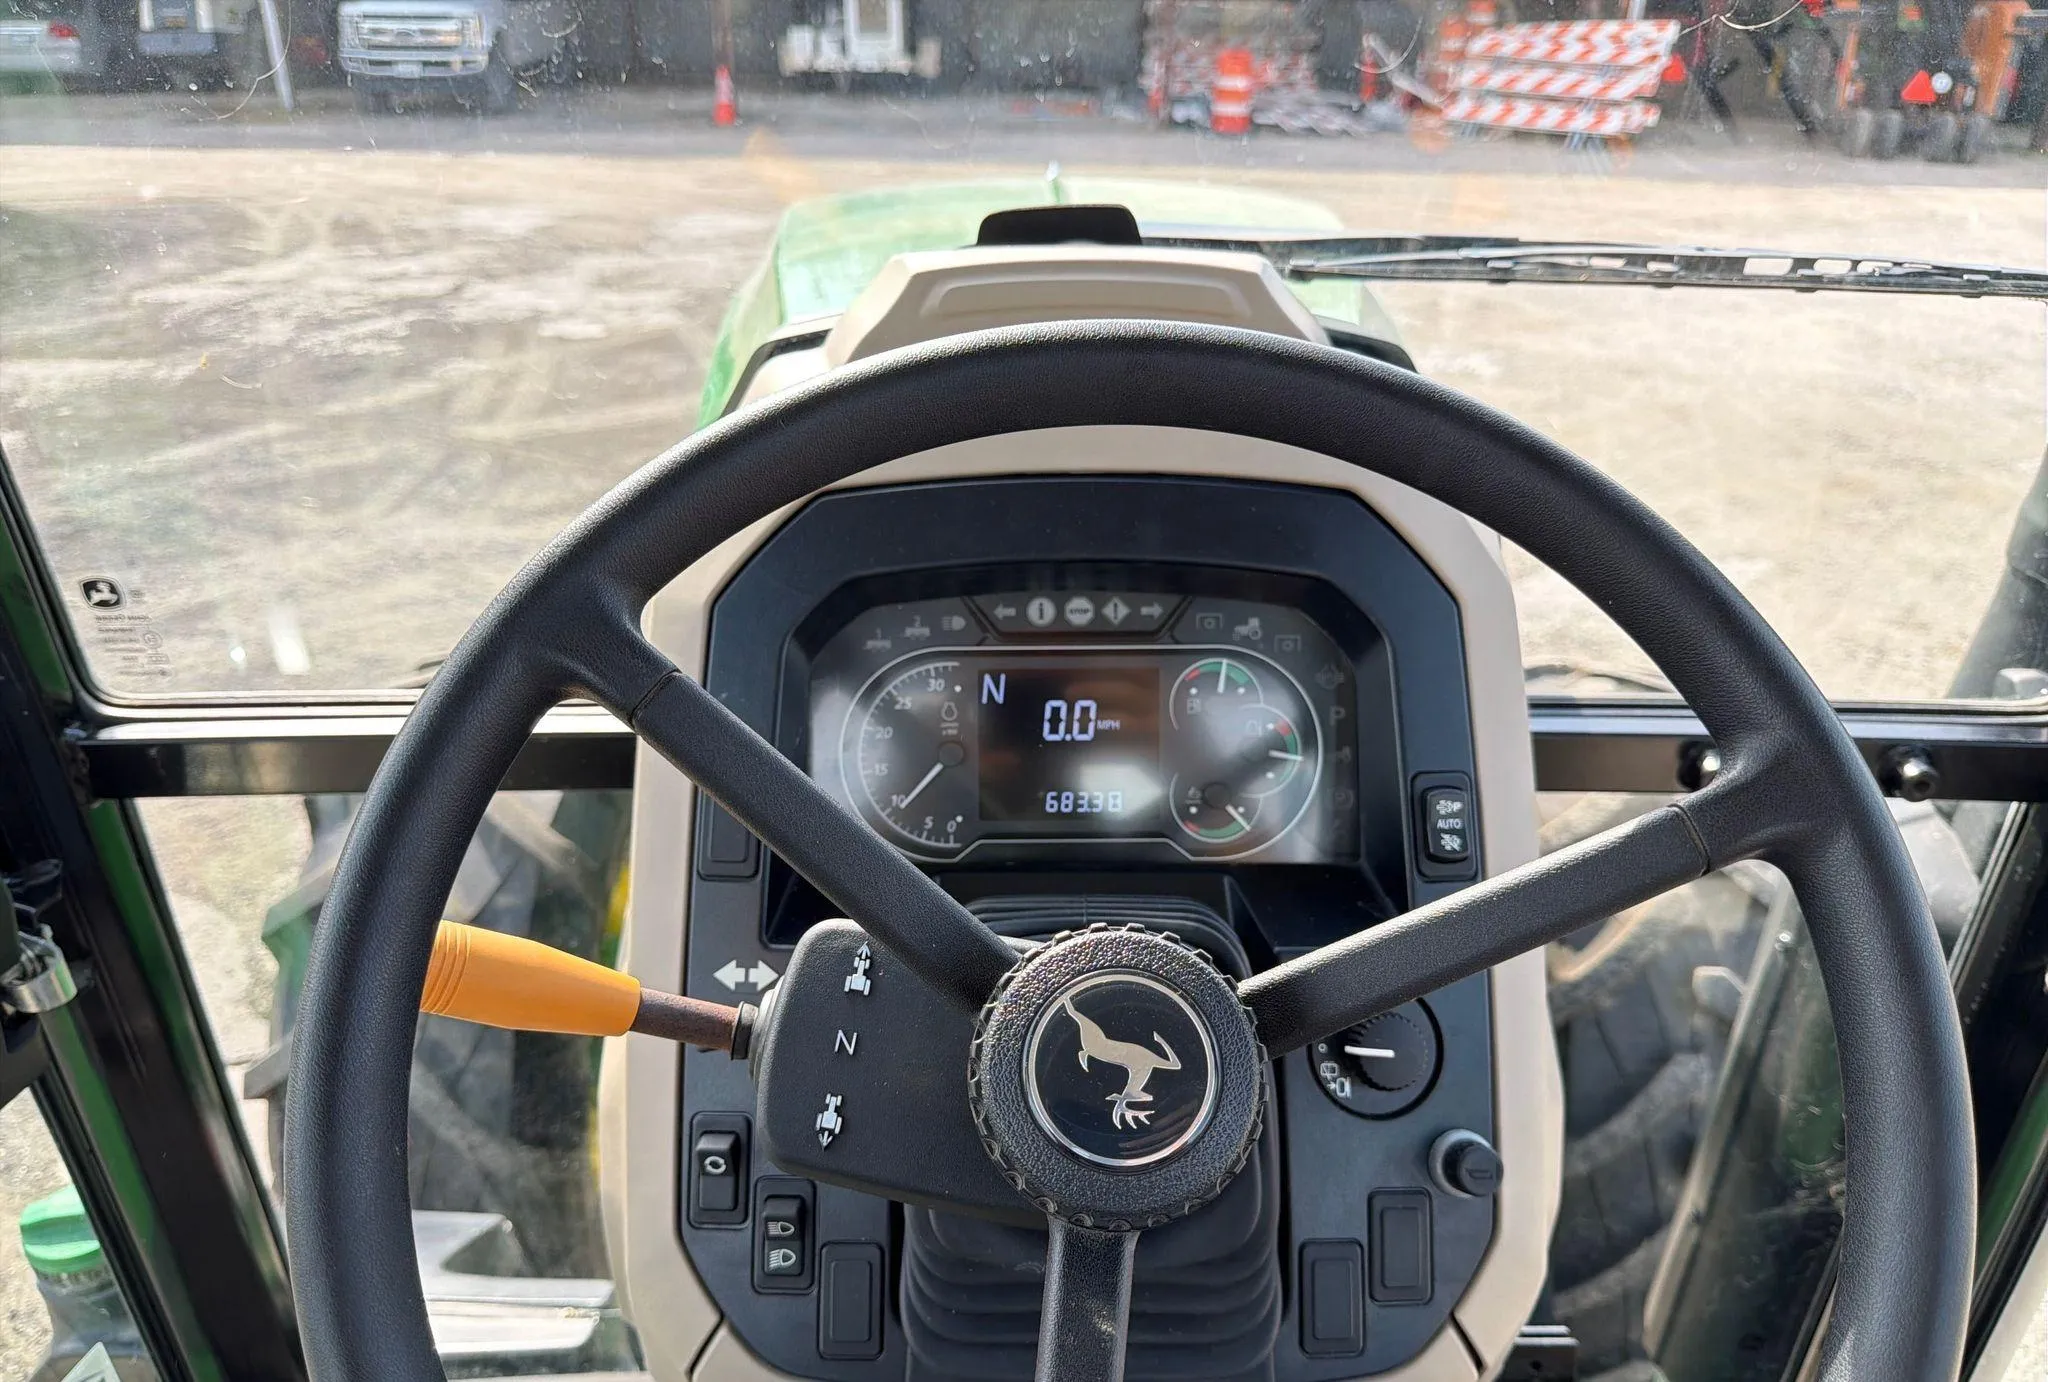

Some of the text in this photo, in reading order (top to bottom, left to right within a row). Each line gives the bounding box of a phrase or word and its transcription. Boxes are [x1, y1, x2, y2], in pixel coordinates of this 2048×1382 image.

[926, 678, 945, 693] 30
[981, 672, 1007, 705] N
[894, 697, 913, 711] 25
[1042, 699, 1121, 742] 0.0 MPH
[875, 726, 894, 740] 20
[874, 763, 889, 777] 15
[891, 794, 907, 808] 10
[924, 816, 934, 829] 5
[947, 820, 957, 833] 0
[1436, 818, 1463, 830] AUTO
[834, 1029, 858, 1056] N
